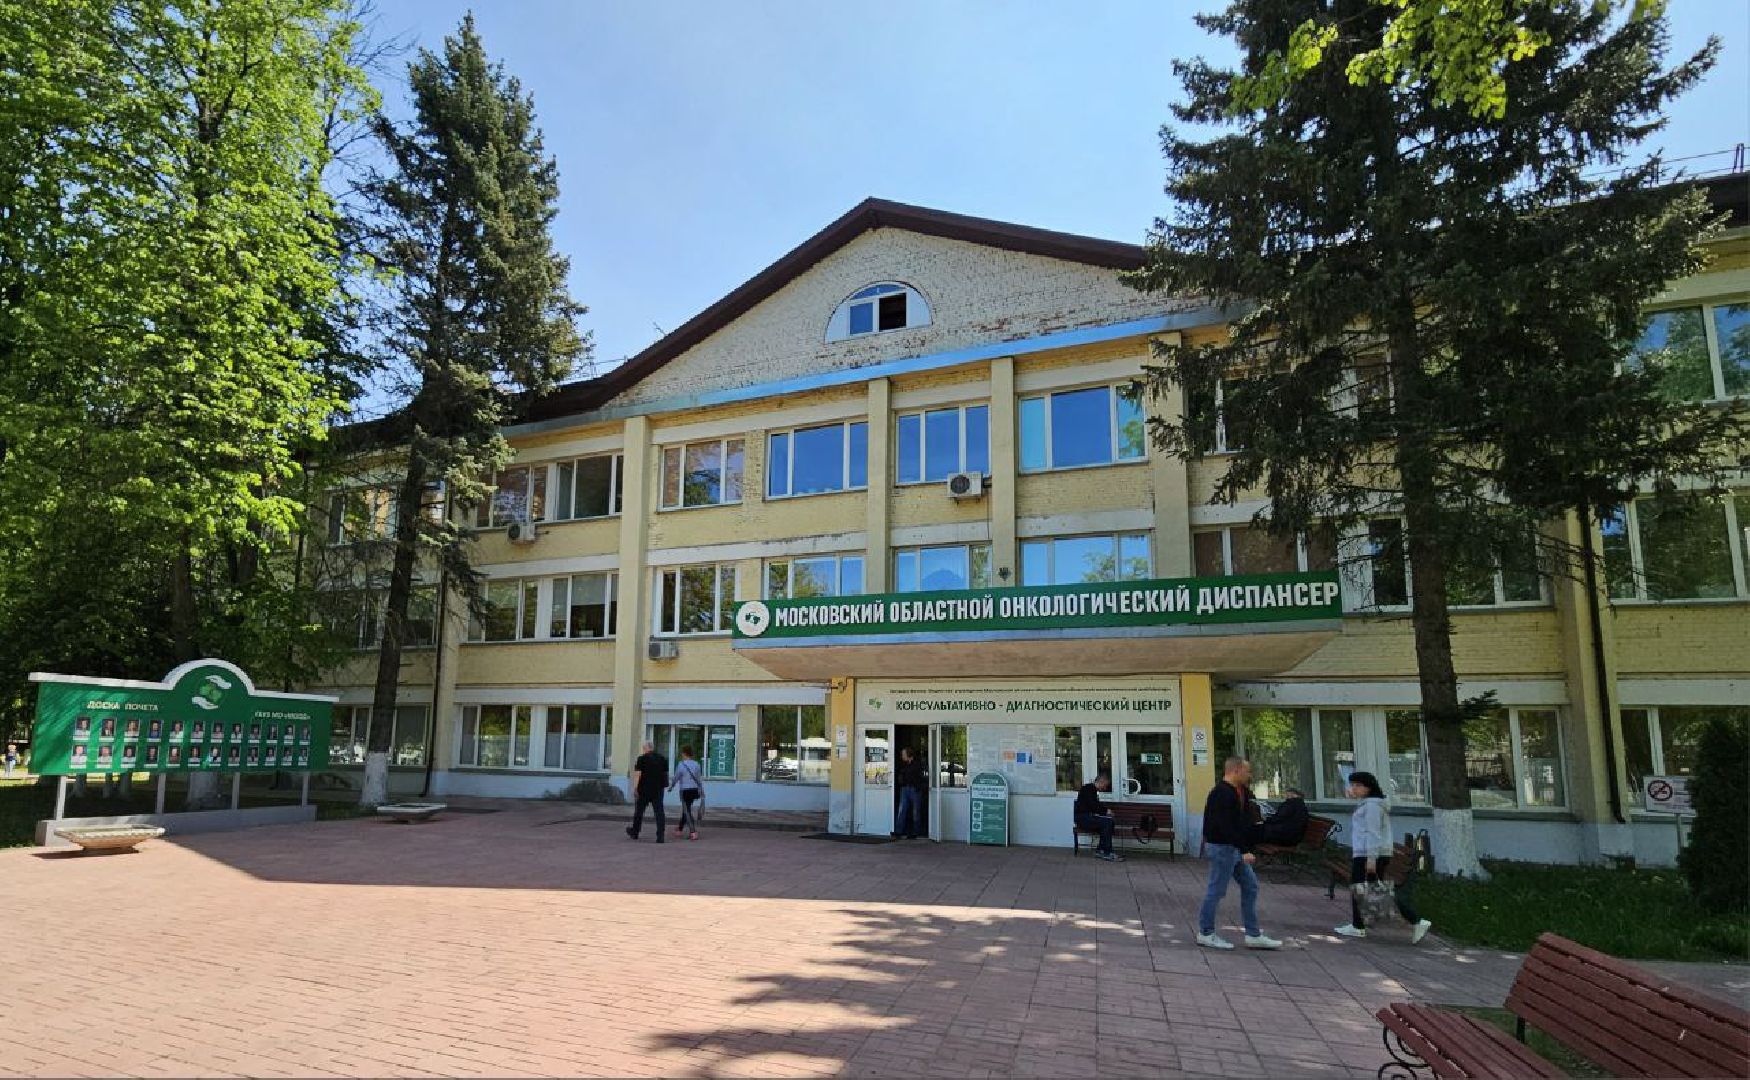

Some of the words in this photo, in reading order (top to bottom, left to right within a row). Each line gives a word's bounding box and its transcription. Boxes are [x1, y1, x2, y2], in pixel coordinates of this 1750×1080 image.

[775, 600, 885, 627] МОСКОВСКИЙ
[889, 593, 994, 623] ОБЛАСТНОЙ
[1000, 585, 1190, 618] ОНКОЛОГИЧЕСКИЙ
[1196, 581, 1339, 616] ДИСПАНСЕР
[896, 700, 996, 711] КОНСУЛЬТАТИВНО
[1006, 697, 1130, 712] ДИАГНОСТИЧЕСКИЙ
[1132, 700, 1172, 713] ЦЕНТР
